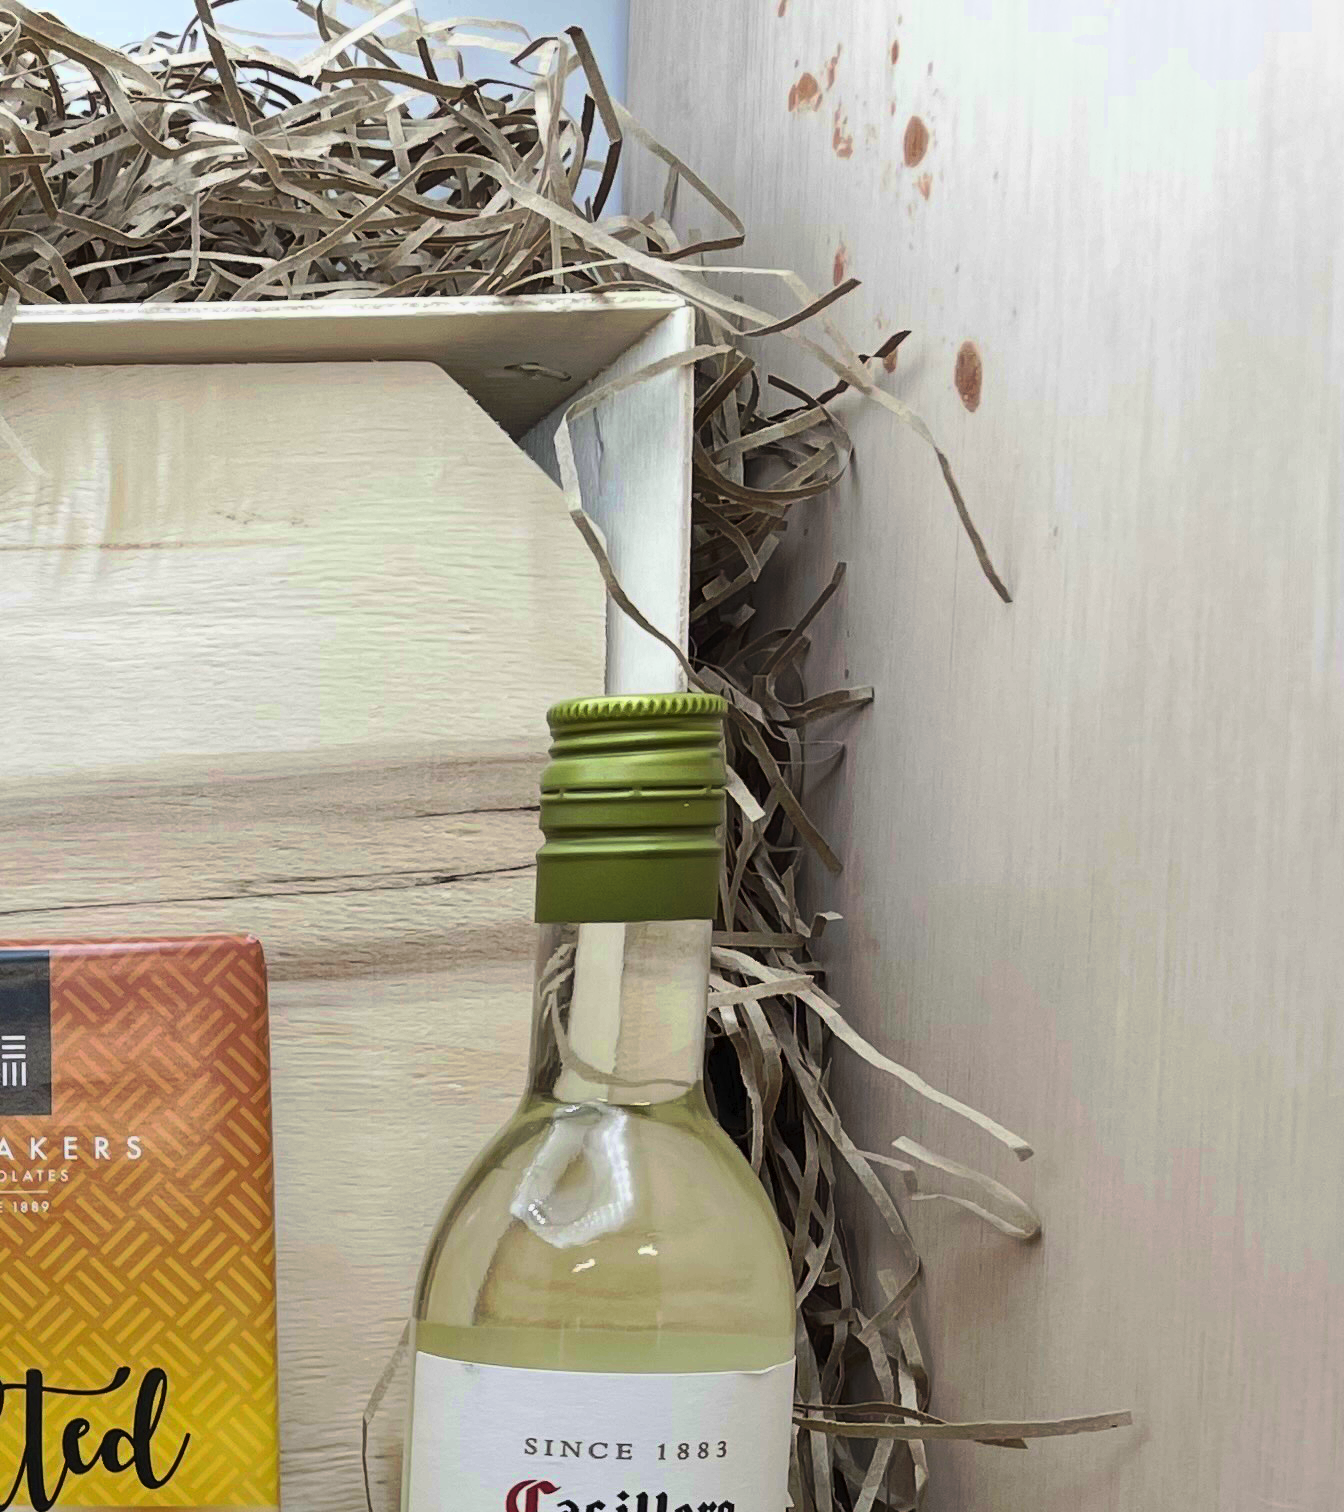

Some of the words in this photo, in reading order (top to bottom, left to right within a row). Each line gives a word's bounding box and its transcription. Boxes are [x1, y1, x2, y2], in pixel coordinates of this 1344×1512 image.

[12, 1200, 51, 1214] 1889
[523, 1437, 634, 1461] SINCE
[656, 1440, 728, 1461] 1883
